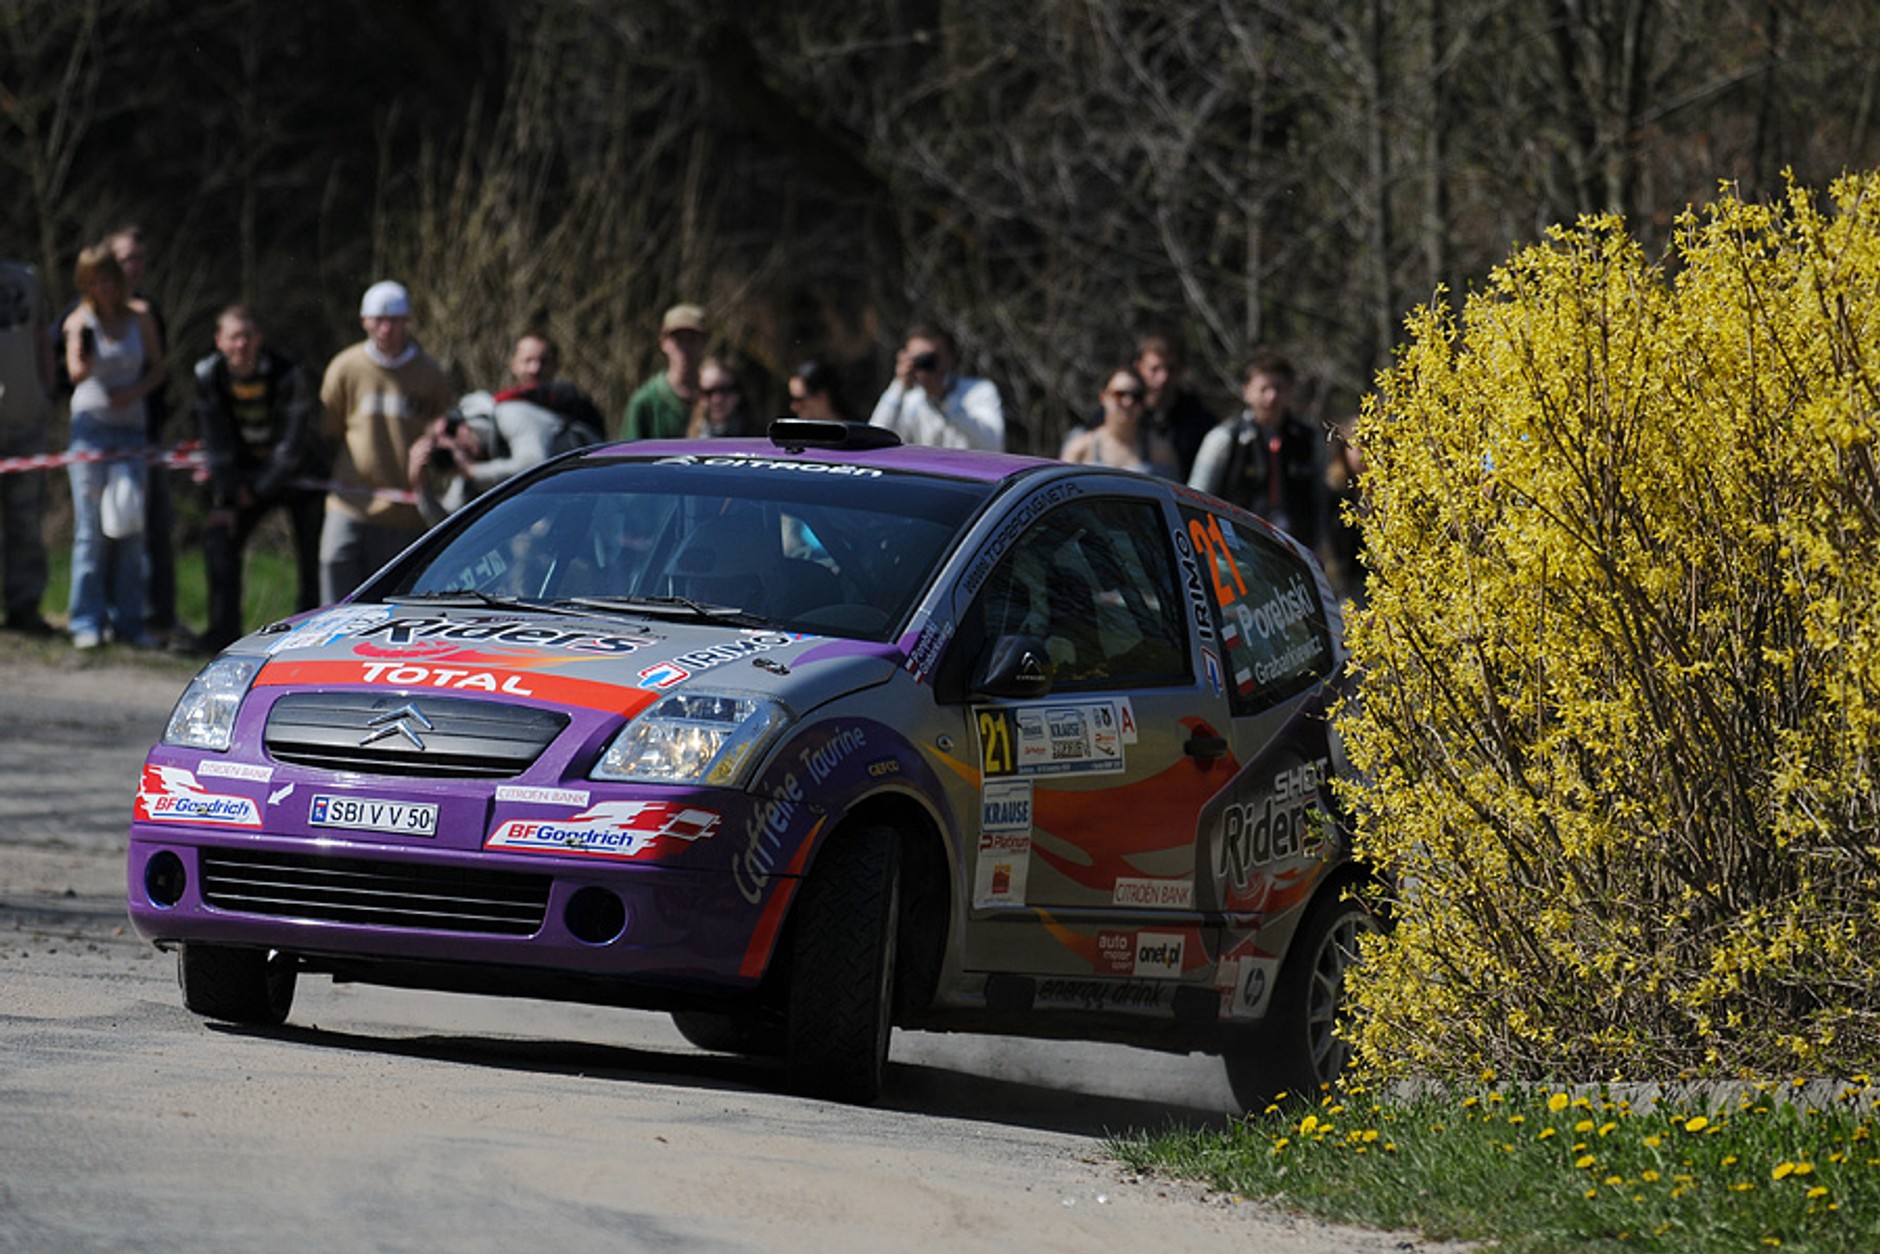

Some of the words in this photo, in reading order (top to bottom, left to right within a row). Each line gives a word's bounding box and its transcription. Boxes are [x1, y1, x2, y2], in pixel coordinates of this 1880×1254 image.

[1188, 511, 1248, 607] 21
[1175, 529, 1214, 641] IRIMO
[356, 616, 659, 655] Riders
[674, 635, 792, 669] IRIMO
[362, 662, 533, 696] TOTAL
[1121, 706, 1136, 734] A
[979, 712, 1012, 773] 21
[331, 801, 365, 822] SBI
[371, 805, 384, 824] V
[389, 807, 403, 825] V
[408, 809, 430, 829] 50
[733, 773, 804, 904] Caffeine
[799, 726, 867, 785] Taurine
[984, 801, 1029, 824] KRAUSE
[1162, 886, 1190, 903] BANK
[1098, 935, 1128, 950] auto
[1139, 942, 1181, 968] onet.pl
[1037, 980, 1110, 1009] energy
[1112, 977, 1166, 1007] drink
